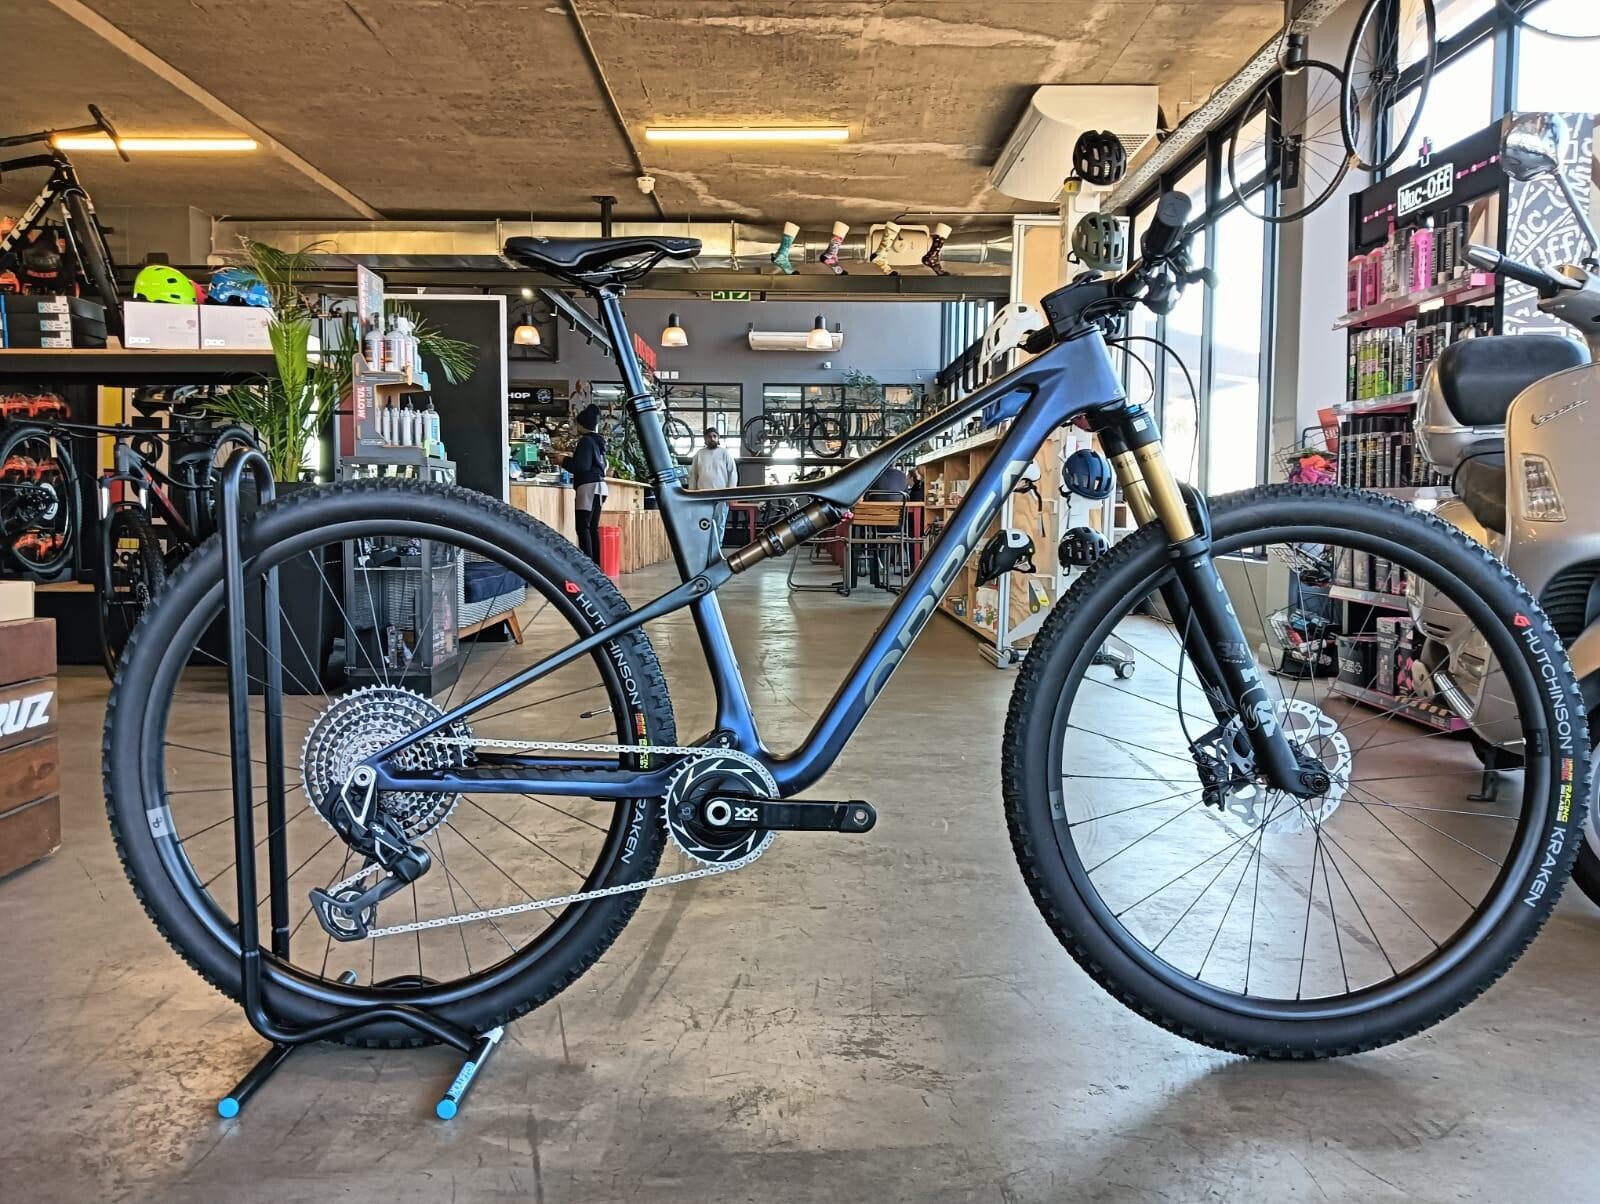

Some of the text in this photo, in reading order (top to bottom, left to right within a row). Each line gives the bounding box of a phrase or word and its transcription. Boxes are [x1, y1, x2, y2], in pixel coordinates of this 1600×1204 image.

[1400, 169, 1450, 211] Muc-Off
[356, 386, 366, 419] MOTUL
[576, 593, 640, 706] HUTHINSON
[1521, 627, 1574, 750] HUTCHINSON
[621, 797, 647, 865] RAKEN
[735, 807, 758, 817] XX
[1561, 784, 1573, 823] RACING
[1523, 826, 1567, 908] KRAKEN
